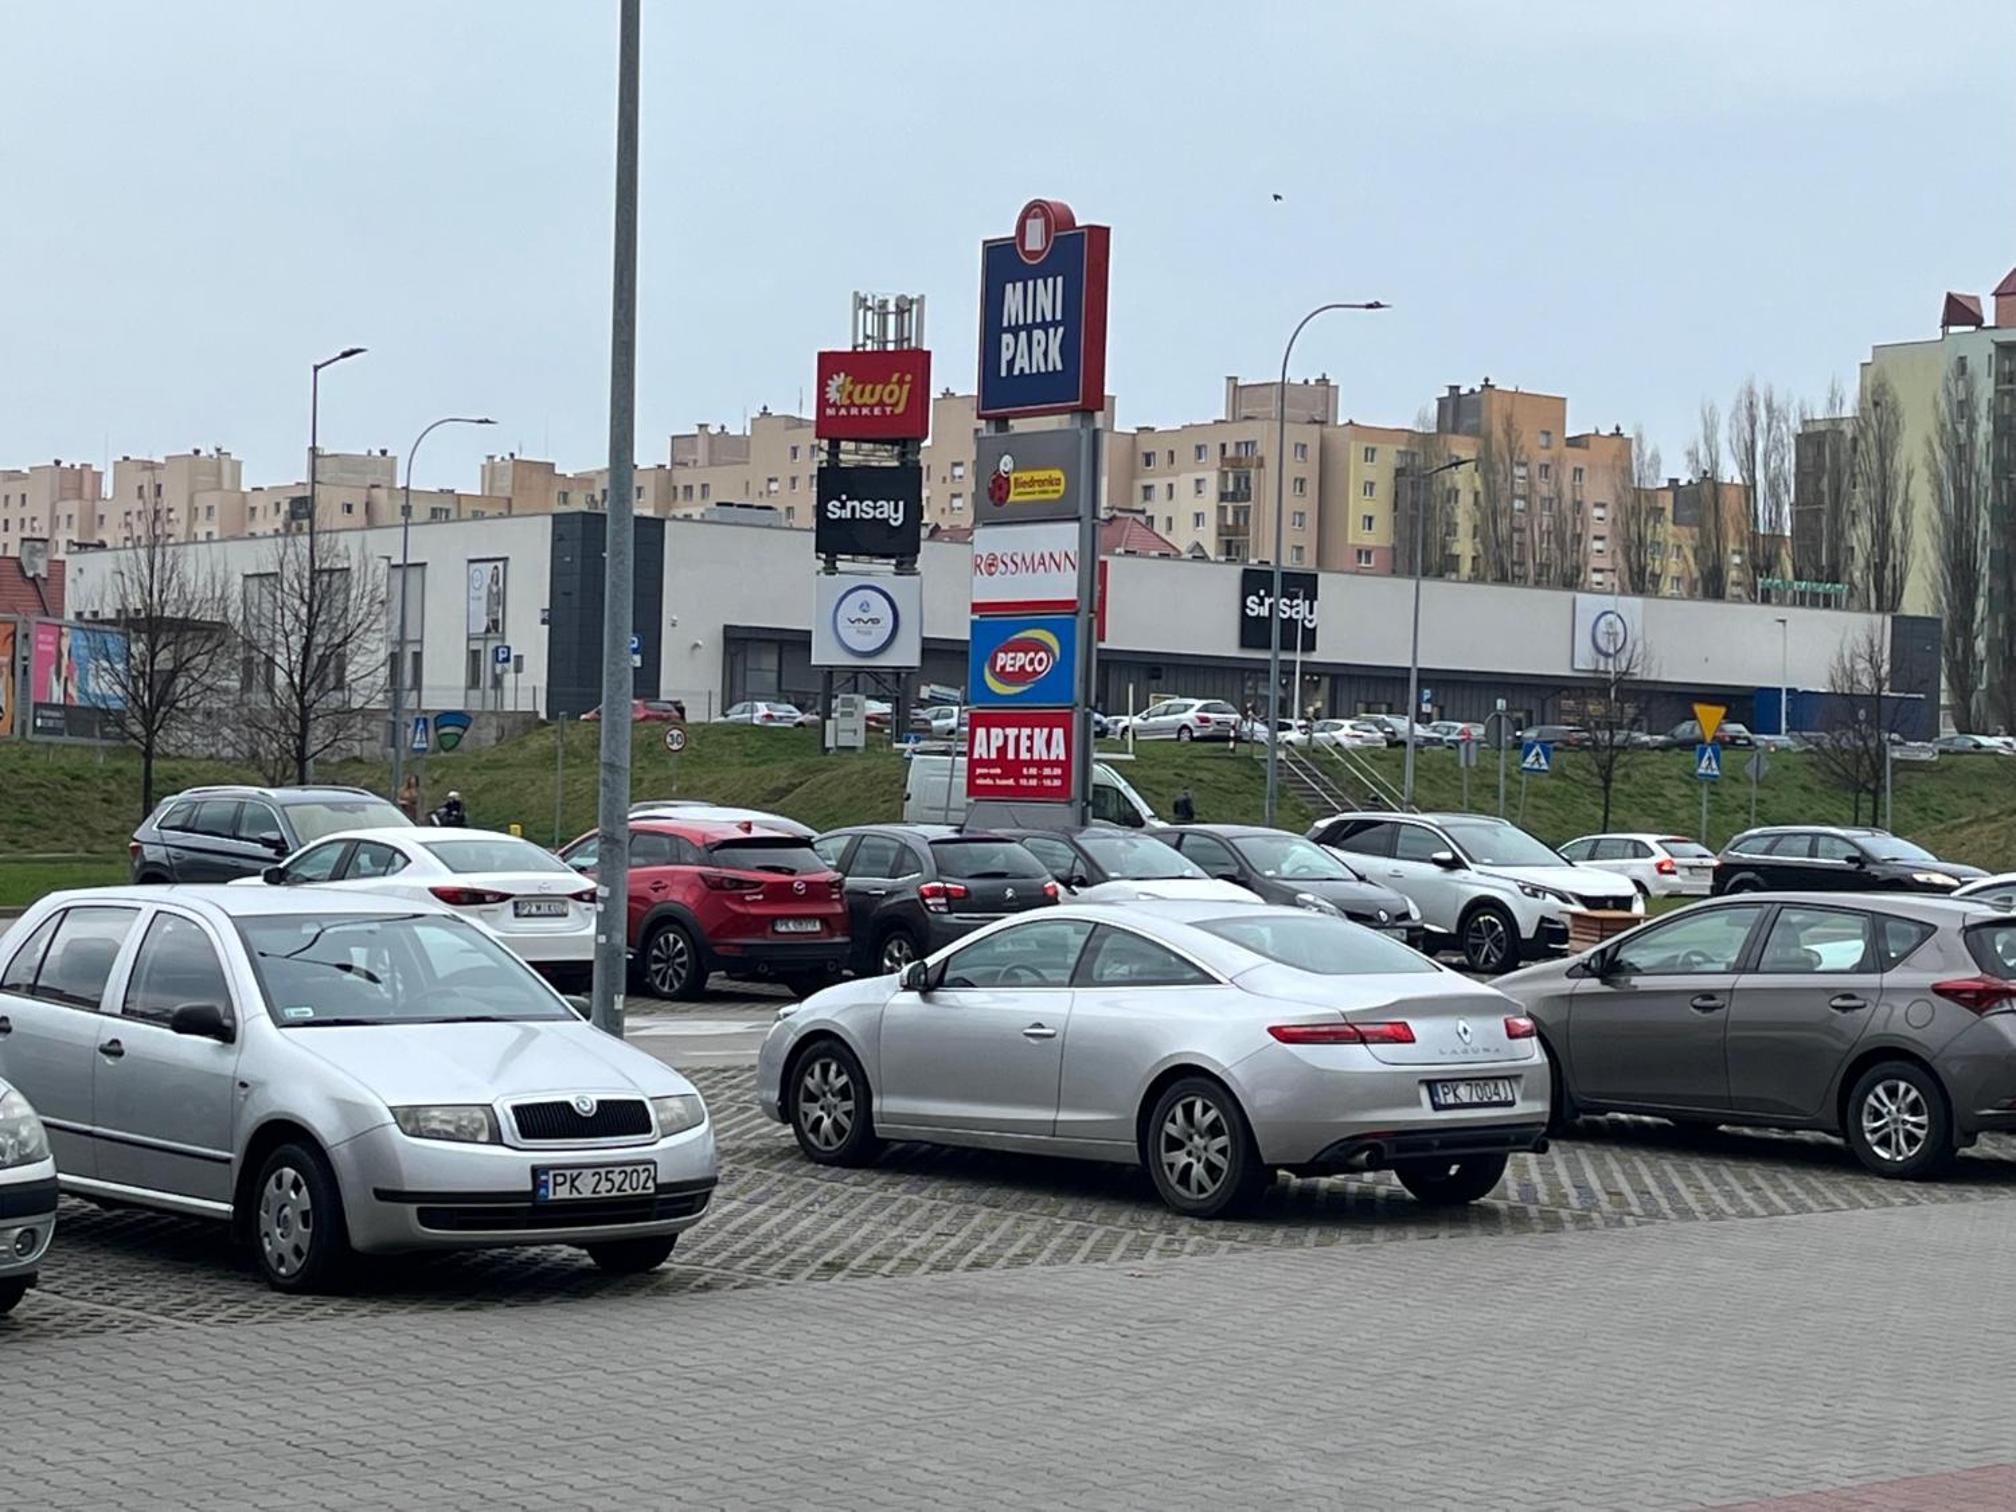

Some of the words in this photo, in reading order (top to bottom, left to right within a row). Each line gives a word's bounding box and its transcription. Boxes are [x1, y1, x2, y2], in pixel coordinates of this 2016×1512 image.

[1002, 276, 1064, 328] MINI
[1000, 326, 1065, 378] PARK
[837, 372, 912, 415] twój
[825, 406, 893, 416] MARKET
[826, 494, 904, 527] sinsay
[973, 551, 1077, 576] ROSSMANN
[498, 647, 509, 662] P
[995, 651, 1048, 673] PEPCO
[668, 733, 685, 746] 30
[973, 727, 1066, 760] APTEKA
[1441, 1083, 1463, 1105] PK
[552, 1172, 583, 1197] PK
[590, 1167, 652, 1195] 25202
